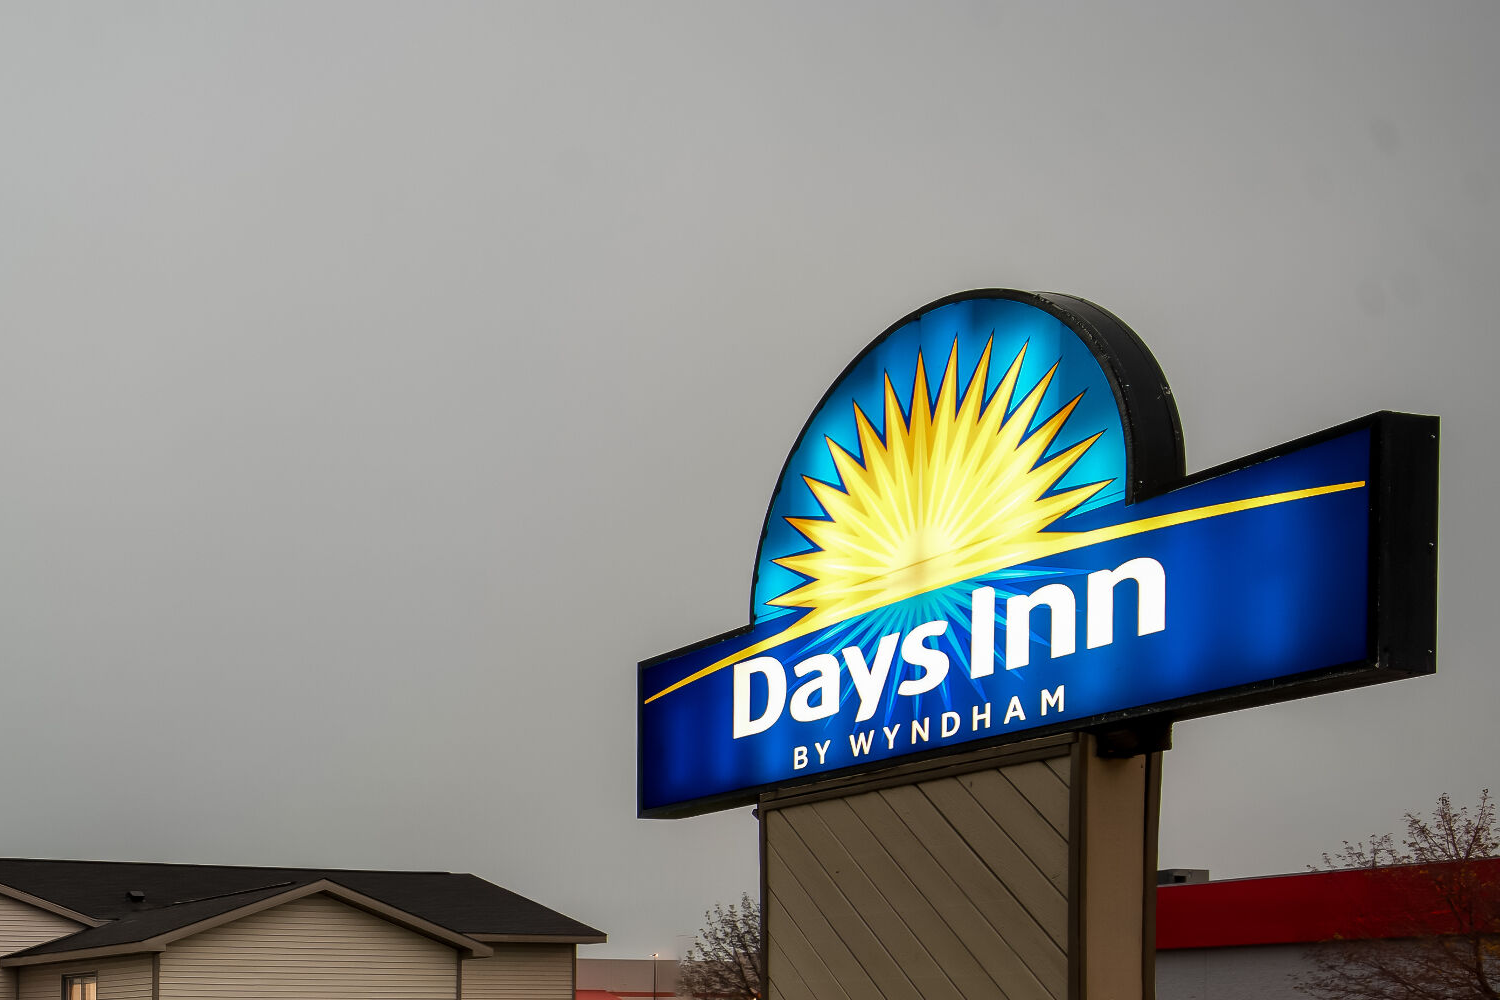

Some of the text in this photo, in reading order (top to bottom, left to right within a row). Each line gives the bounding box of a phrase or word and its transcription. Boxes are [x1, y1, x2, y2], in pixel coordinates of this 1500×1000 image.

[732, 556, 1167, 741] Days Inn
[793, 684, 1066, 770] BY WYNDHAM
